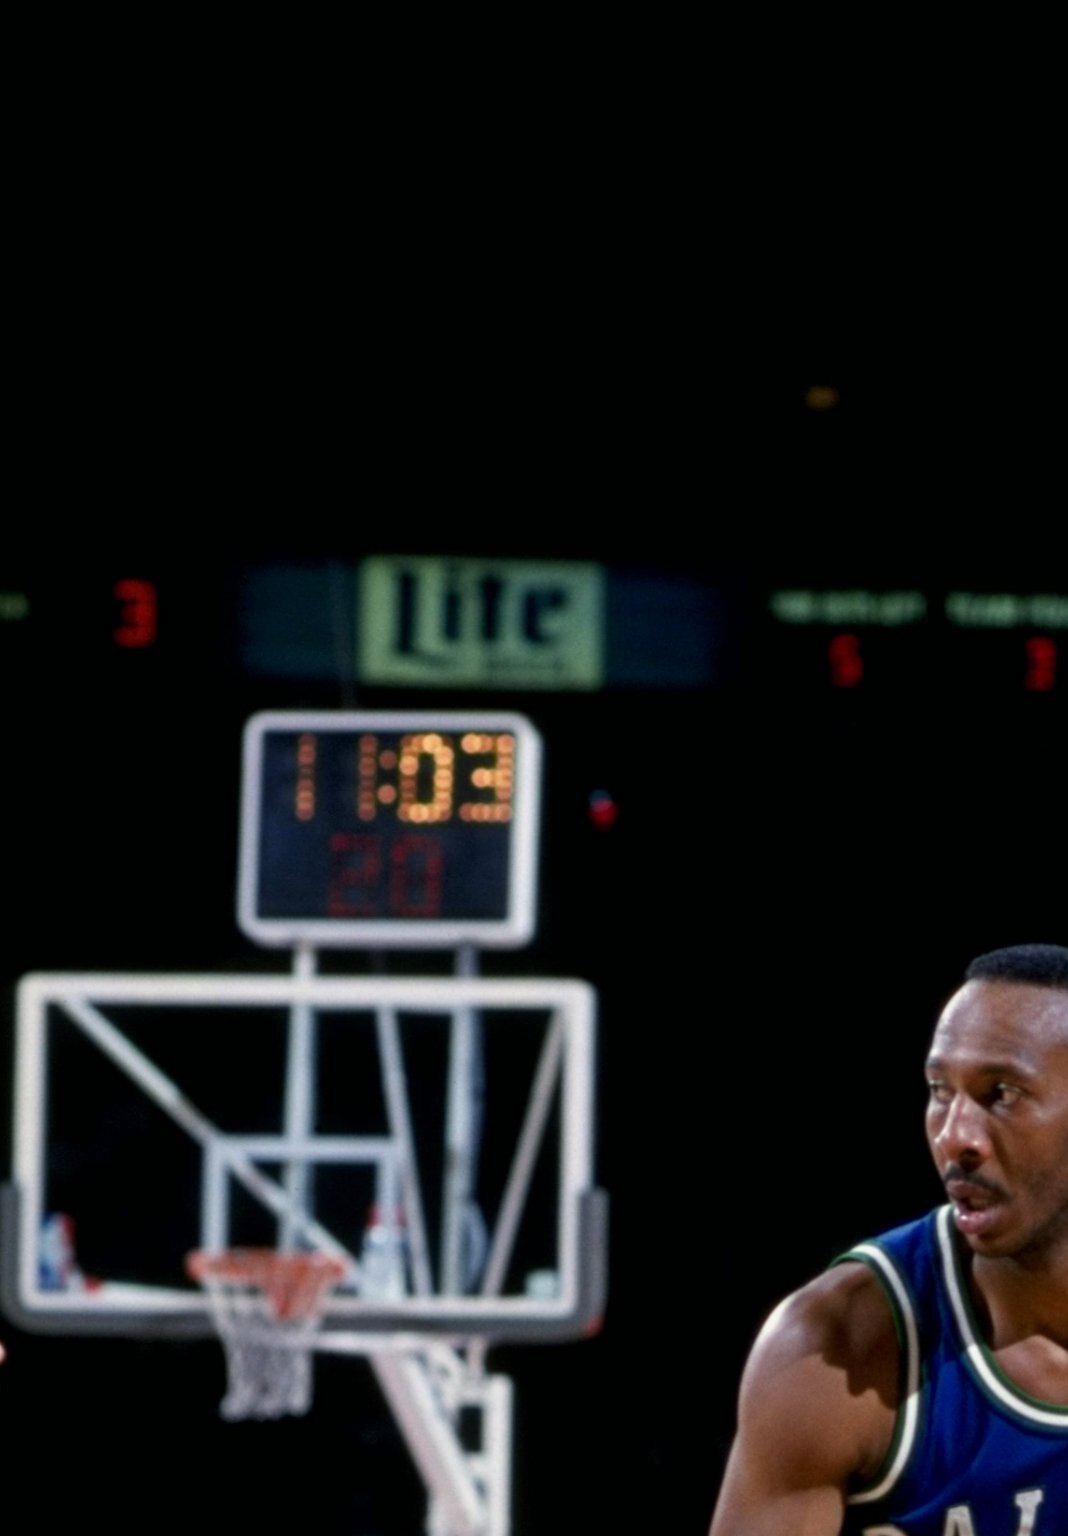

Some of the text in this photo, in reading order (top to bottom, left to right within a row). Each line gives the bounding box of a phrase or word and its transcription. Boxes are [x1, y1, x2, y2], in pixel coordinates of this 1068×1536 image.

[113, 578, 157, 648] 3
[296, 733, 514, 823] 11:03
[328, 833, 443, 918] 20
